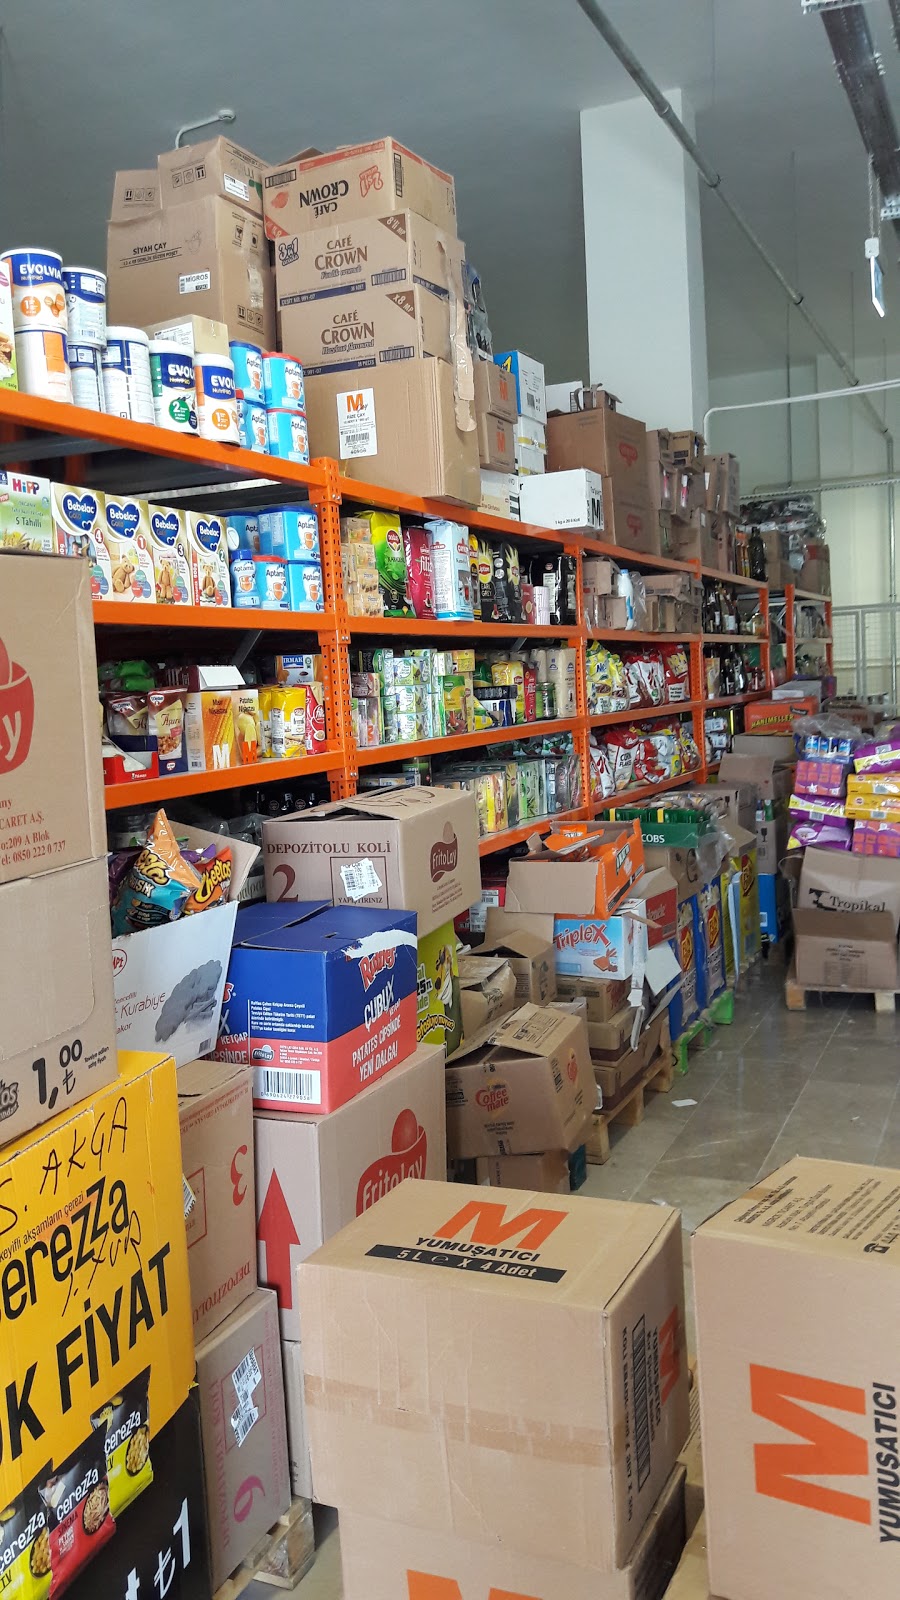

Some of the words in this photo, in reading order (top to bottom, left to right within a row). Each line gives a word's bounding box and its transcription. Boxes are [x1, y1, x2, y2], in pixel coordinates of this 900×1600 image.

[299, 179, 349, 208] CROWN
[315, 201, 338, 218] CAFÉ
[133, 246, 153, 256] SİYAH
[154, 242, 167, 254] ÇAY
[327, 235, 353, 250] CAFÉ
[314, 246, 368, 271] CROWN
[19, 263, 61, 281] EVOLVIA
[333, 310, 359, 324] CAFÉ
[321, 321, 375, 345] CROWN
[172, 401, 180, 412] 2
[12, 478, 40, 495] HiPP
[67, 499, 95, 514] Bebelac
[109, 508, 138, 522] Bebelac
[154, 518, 178, 531] Bebelac
[199, 525, 220, 537] Bebelac
[96, 530, 103, 543] 4
[139, 536, 145, 549] 1
[178, 544, 184, 556] 3
[212, 743, 230, 770] M
[241, 740, 258, 765] M
[32, 829, 50, 843] Blok
[12, 848, 31, 863] 0850
[32, 845, 46, 859] 222
[47, 843, 52, 854] 0
[53, 839, 66, 853] 737
[266, 841, 350, 854] DEPOZİTOLU
[356, 840, 391, 854] KOLİ
[194, 859, 232, 903] Cheetos
[272, 863, 299, 902] 2
[829, 895, 886, 912] Tropikal
[120, 992, 166, 1018] Kurabiye
[220, 1031, 248, 1046] KETÇAP
[352, 1034, 378, 1068] PATATES
[360, 1055, 374, 1082] YENİ
[375, 1040, 398, 1072] DALGA!
[475, 1088, 508, 1107] Coffee
[486, 1096, 509, 1112] mate
[230, 1144, 248, 1206] 3
[63, 1190, 84, 1215] çerezi
[432, 1200, 570, 1251] M
[415, 1236, 541, 1263] YUMUŞATICI
[397, 1249, 409, 1259] 5
[412, 1252, 423, 1261] L
[480, 1261, 492, 1271] 4
[494, 1263, 537, 1279] Adet
[55, 1248, 171, 1415] FİYAT
[749, 1363, 871, 1526] M
